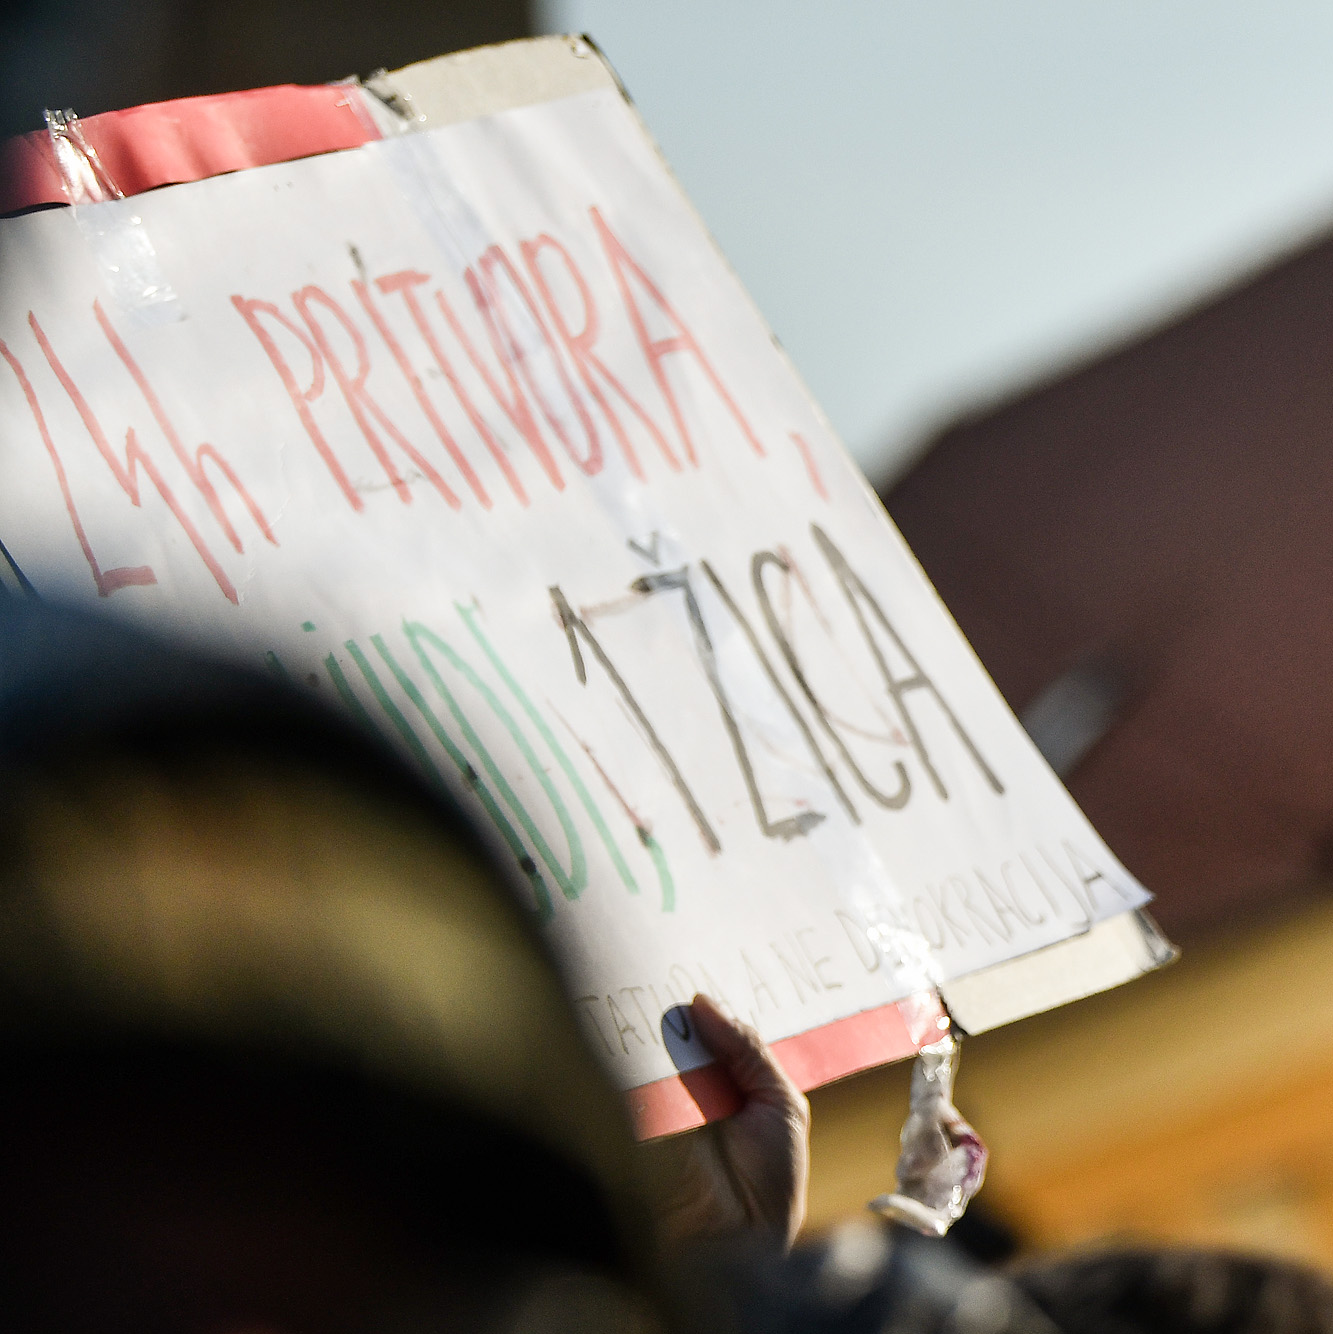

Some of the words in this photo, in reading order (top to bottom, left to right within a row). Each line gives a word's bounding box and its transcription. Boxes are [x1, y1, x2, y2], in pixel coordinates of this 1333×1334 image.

[627, 522, 1005, 841] ŽICA
[769, 926, 846, 1007] NE
[833, 837, 1134, 975] DOKRACIJA
